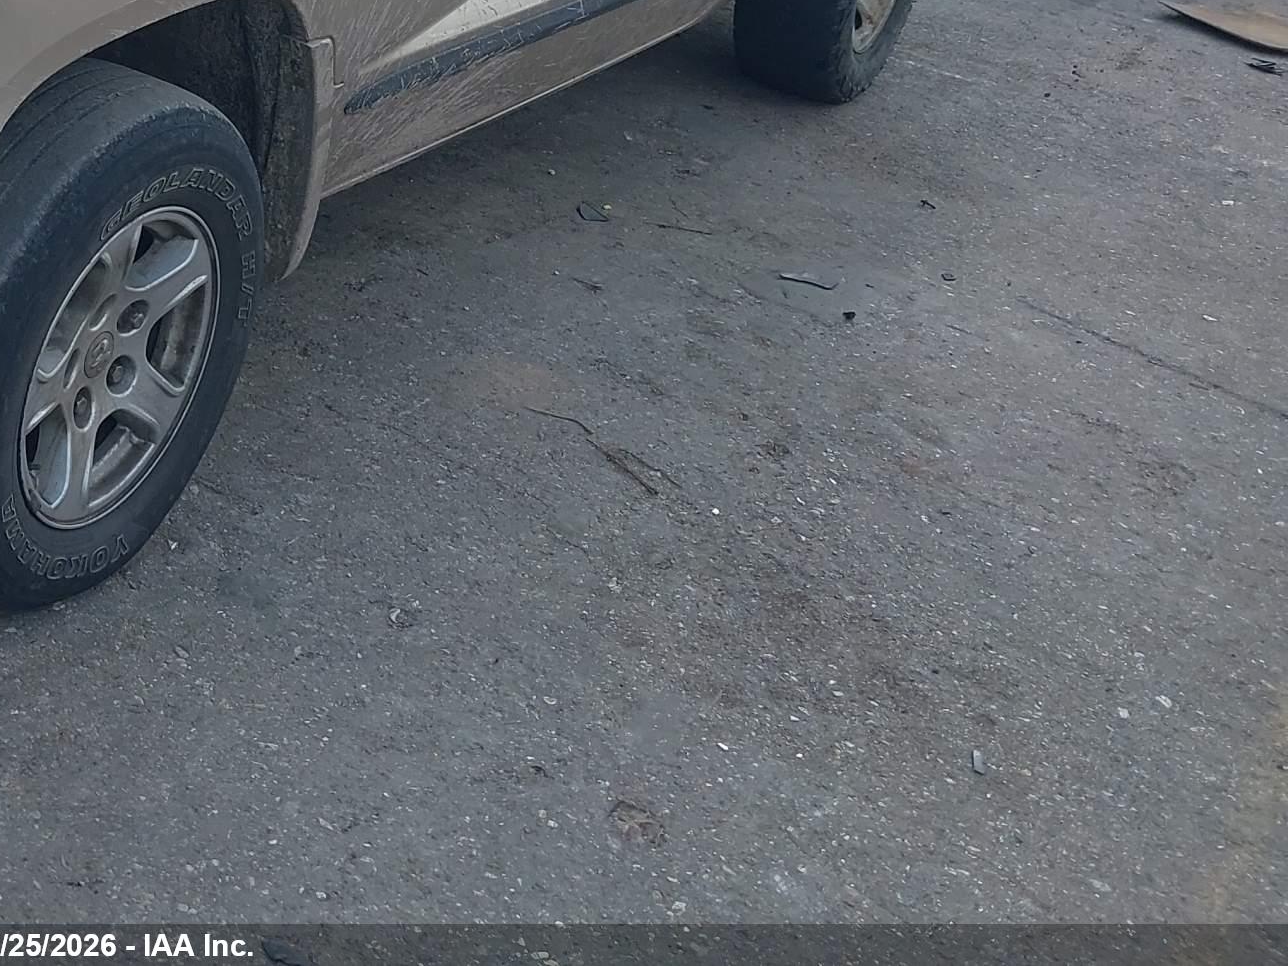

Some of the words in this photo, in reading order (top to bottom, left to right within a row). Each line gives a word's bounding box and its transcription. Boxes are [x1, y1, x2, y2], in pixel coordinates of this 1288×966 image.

[100, 167, 253, 241] GEOLANDAR
[238, 250, 257, 321] H/T
[1, 493, 130, 580] YOKOHAMA
